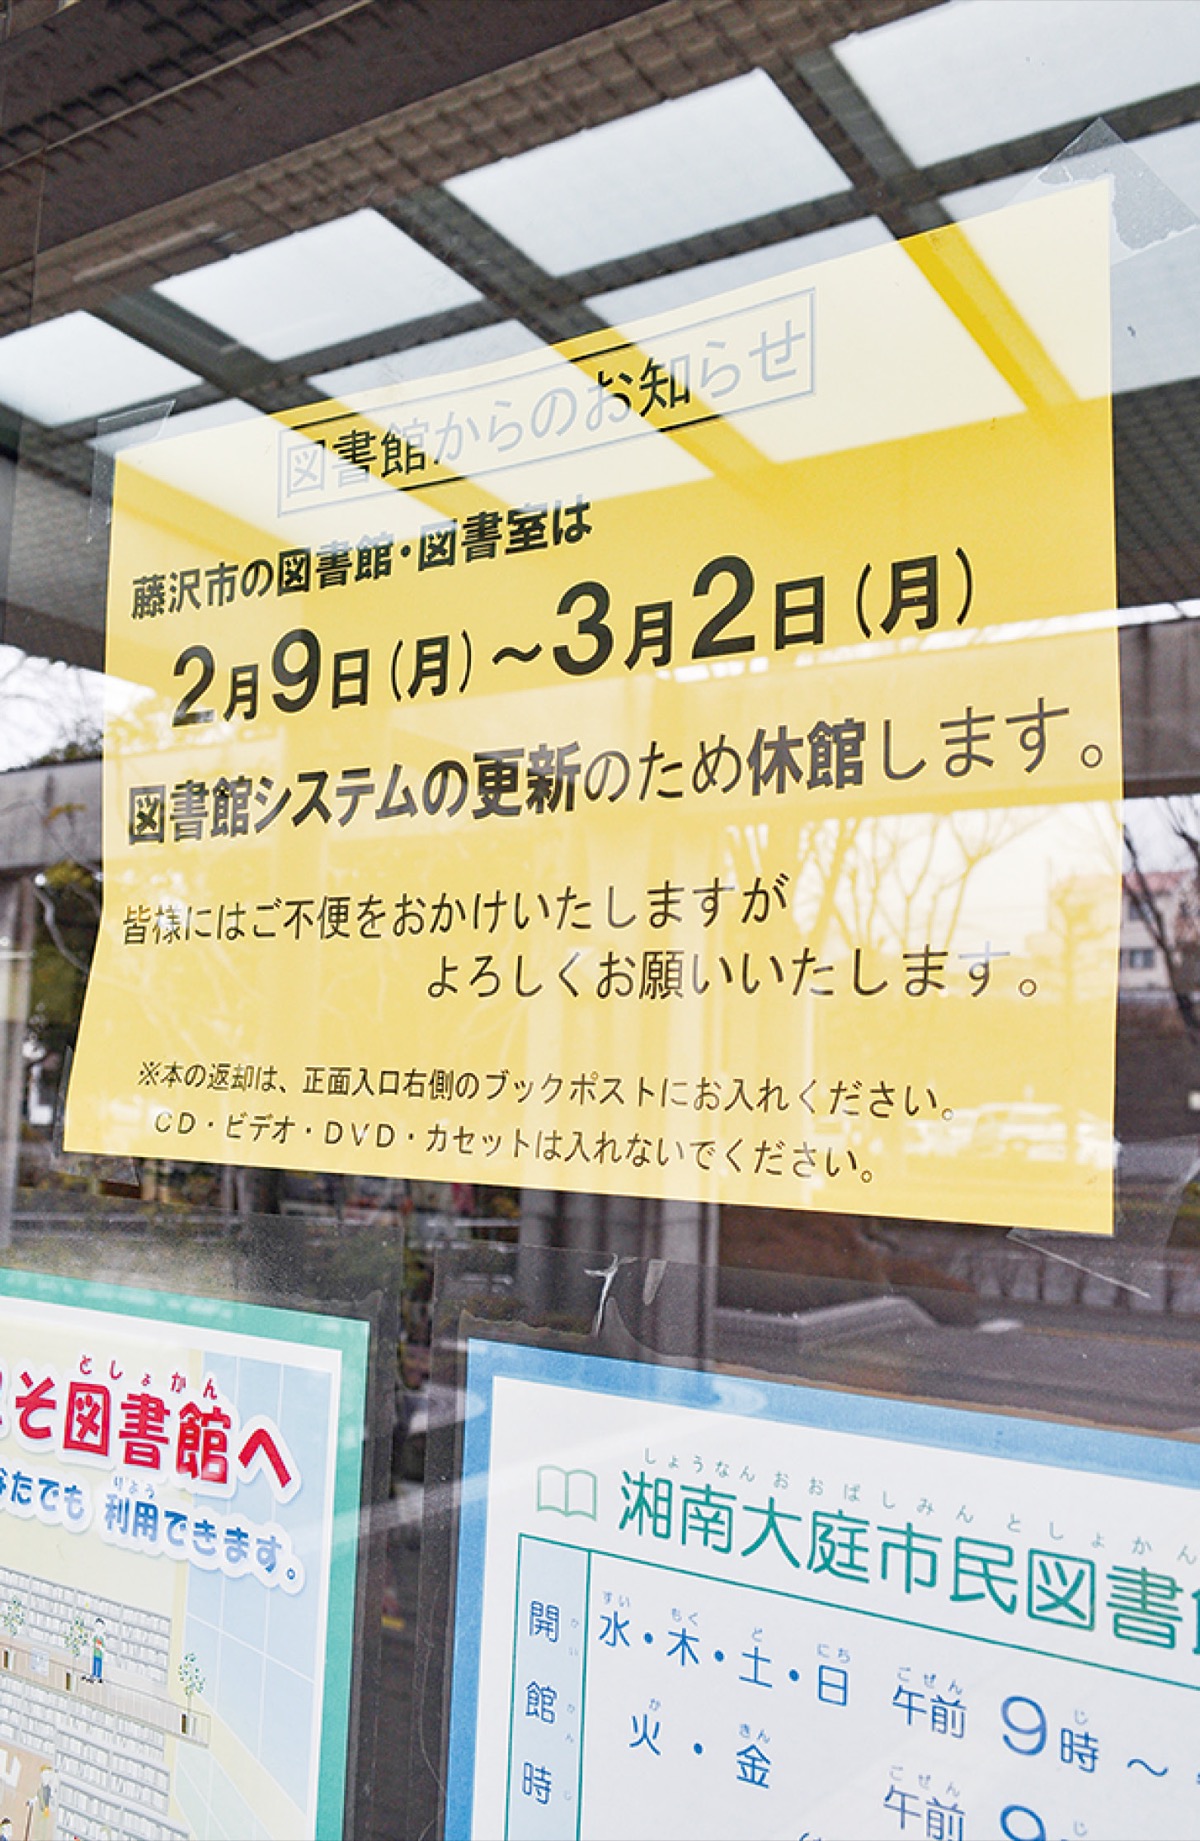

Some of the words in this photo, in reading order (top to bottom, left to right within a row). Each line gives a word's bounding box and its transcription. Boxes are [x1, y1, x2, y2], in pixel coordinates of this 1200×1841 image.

[285, 319, 806, 498] 図書館からのお知らせ
[131, 494, 592, 620] 藤沢市の図書館・図書室は
[127, 696, 1104, 846] 図書館システムの更新のため休館します。
[122, 872, 790, 946] 皆様にはご不便をおかけいたしますが
[427, 940, 1038, 1001] よろしくお願いいたします。
[0, 1371, 293, 1489] そ図書館へ
[78, 1354, 218, 1400] としょかん
[618, 1470, 1200, 1656] 湘南大庭市民図書
